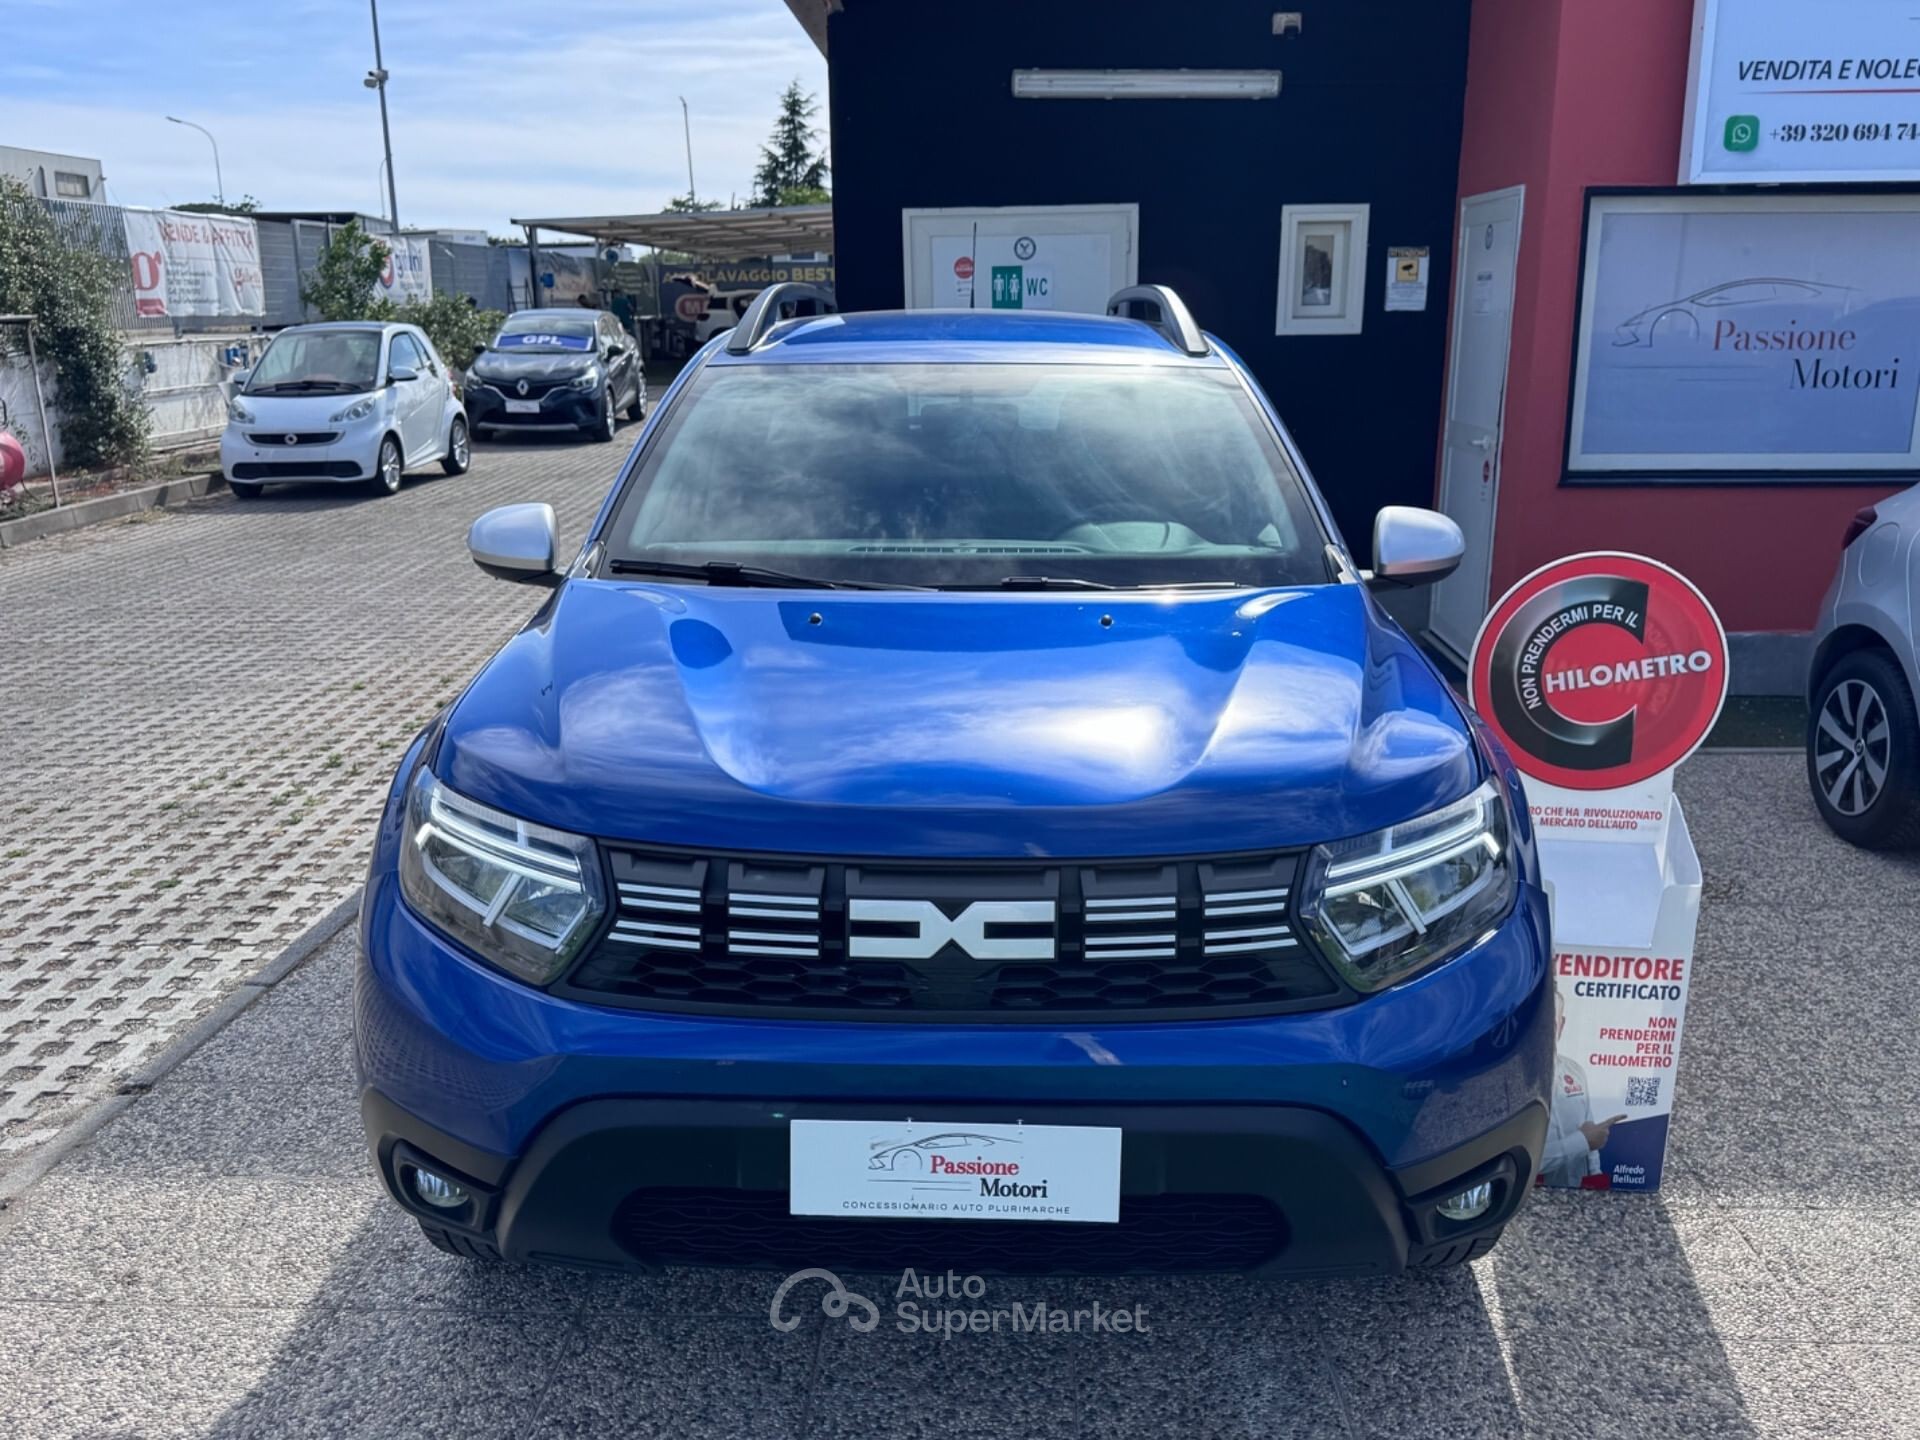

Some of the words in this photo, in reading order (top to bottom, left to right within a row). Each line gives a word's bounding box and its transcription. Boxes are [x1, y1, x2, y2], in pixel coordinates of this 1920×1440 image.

[1738, 59, 1833, 81] VENDITA
[1837, 58, 1853, 80] E
[1855, 57, 1920, 80] NOLE
[1769, 123, 1807, 142] +39
[1809, 123, 1849, 142] 320
[1852, 122, 1893, 141] 694
[1896, 122, 1920, 141] 74
[662, 269, 788, 284] AOLAVAGGIO
[791, 266, 835, 283] BEST
[1026, 277, 1048, 297] WC
[522, 334, 563, 346] GPL
[1712, 319, 1856, 352] Passione
[1789, 358, 1900, 390] Motori
[1592, 603, 1623, 622] PER
[1626, 610, 1640, 629] IL
[1522, 605, 1589, 675] PRENDERMI
[1545, 650, 1713, 694] HILOMETRO
[1521, 676, 1542, 711] NON
[1544, 806, 1563, 816] CHE
[1566, 806, 1580, 817] HA
[1583, 807, 1663, 821] RIVOLUZIONATO
[1539, 816, 1586, 829] MERCATO
[1587, 818, 1638, 831] DELL'AUTO
[1554, 953, 1685, 981] ENDITORE
[1574, 981, 1682, 1001] CERTIFICATO
[1648, 1016, 1677, 1029] NON
[1599, 1028, 1676, 1042] PRENDERMI
[1636, 1042, 1660, 1055] PER
[1662, 1043, 1674, 1055] IL
[1589, 1053, 1673, 1069] CHILOMETRO
[930, 1154, 1020, 1177] Passione
[1613, 1163, 1645, 1175] Alfredo
[979, 1178, 1048, 1199] Motori
[1612, 1174, 1646, 1186] Bellucci
[842, 1200, 949, 1212] CONCESSIONARIO
[952, 1203, 984, 1213] AUTO
[987, 1204, 1072, 1215] PLURIMARCHE
